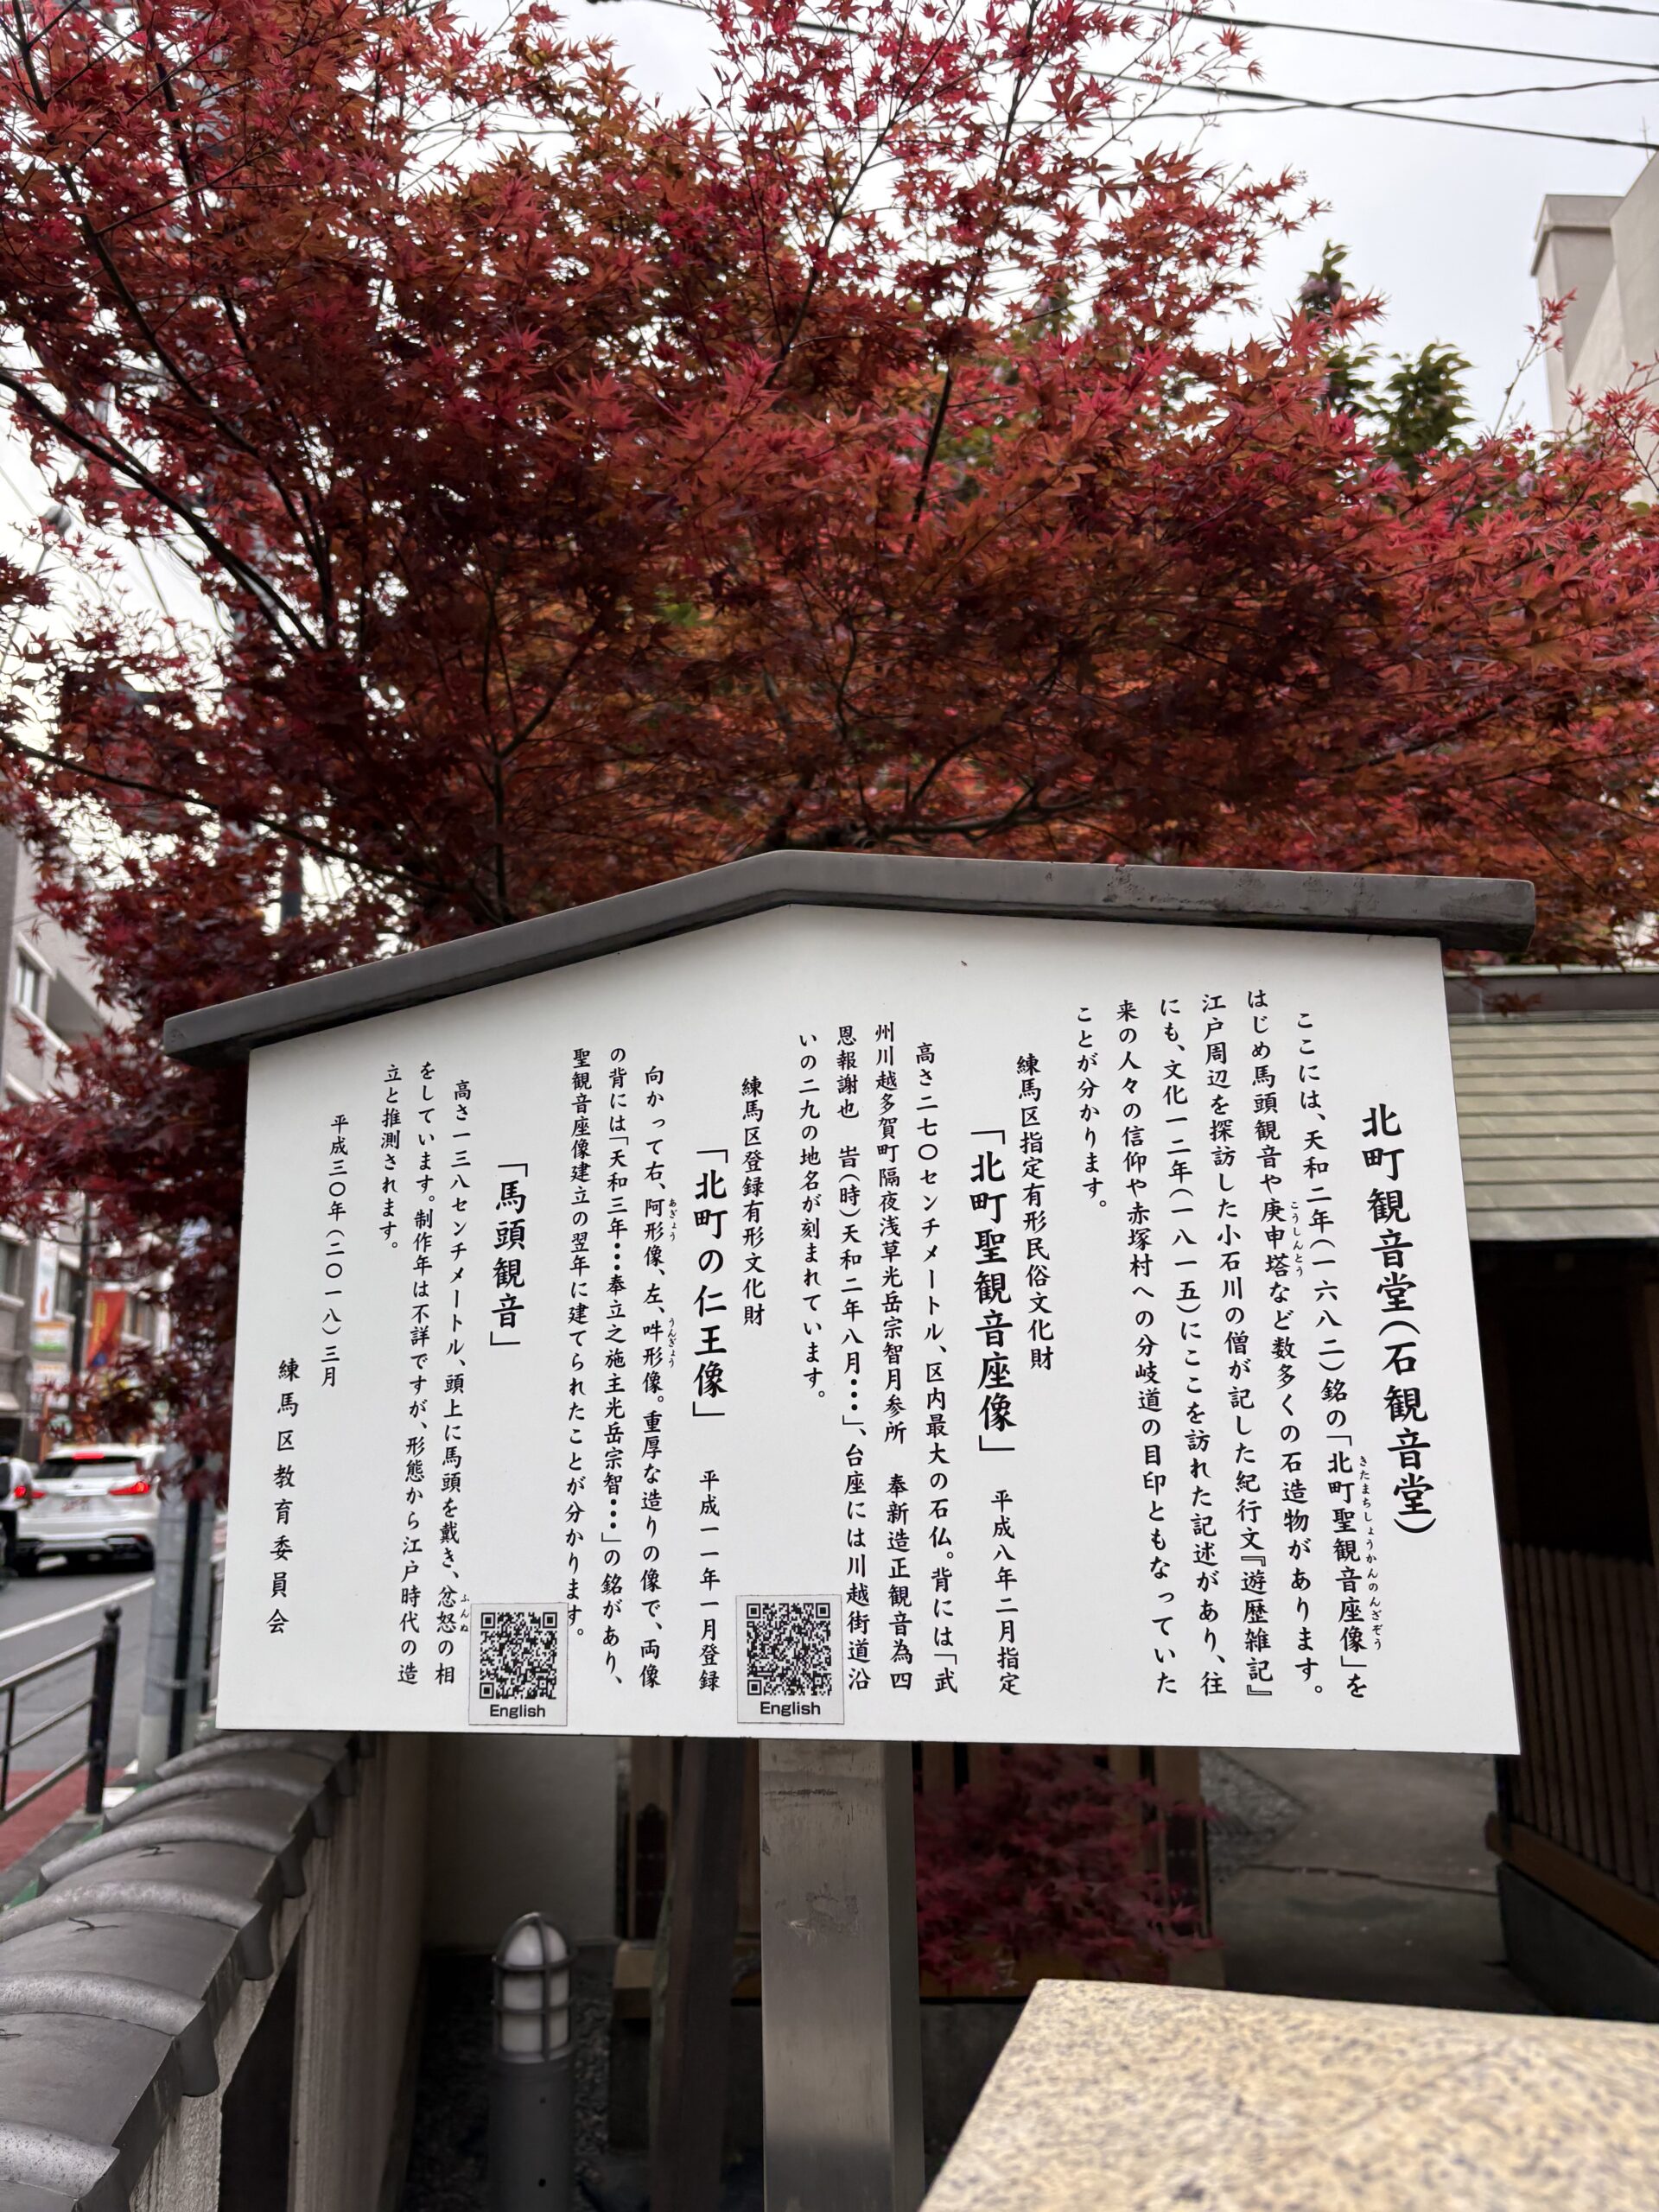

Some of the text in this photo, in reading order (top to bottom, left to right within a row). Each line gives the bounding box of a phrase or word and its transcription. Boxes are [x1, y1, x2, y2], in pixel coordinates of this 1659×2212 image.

[379, 1065, 402, 1248] 立と推測されます。
[741, 1076, 766, 1326] 練馬区登録有形文化財
[836, 1026, 859, 1118] 恩報謝也
[1077, 1007, 1106, 1207] ことが分かります。
[490, 1163, 528, 1345] 「馬頭観音」
[565, 1048, 592, 1636] 聖観音座像建立の翌年に建てられたことが分かります。
[798, 1035, 825, 1397] いの二九の地名が刻まれています。
[1017, 1053, 1054, 1370] 練馬区指定有形民俗文化財
[1116, 1000, 1177, 1694] 来の人々の信仰や赤塚村への分岐道の目印ともなっていた
[1248, 989, 1322, 1693] はじめ馬頭観音や庚申塔など数多くの石造物があります。
[1290, 1200, 1304, 1277] こうしんとう
[1362, 1103, 1436, 1533] 北町観音堂（石観音堂）
[693, 1149, 728, 1691] 「北町の仁王像」 平成一一年一月登録
[875, 1021, 912, 1690] 州川越多賀町隔夜浅草光岳宗智月参所 奉新造正観音為四
[969, 1130, 1020, 1695] 「北町聖観音座像」 平成八年二月指定
[266, 1357, 300, 1633] 練馬区教育委員会
[460, 1594, 470, 1632] ふんぬ
[490, 1704, 545, 1719] English
[760, 1700, 822, 1717] English
